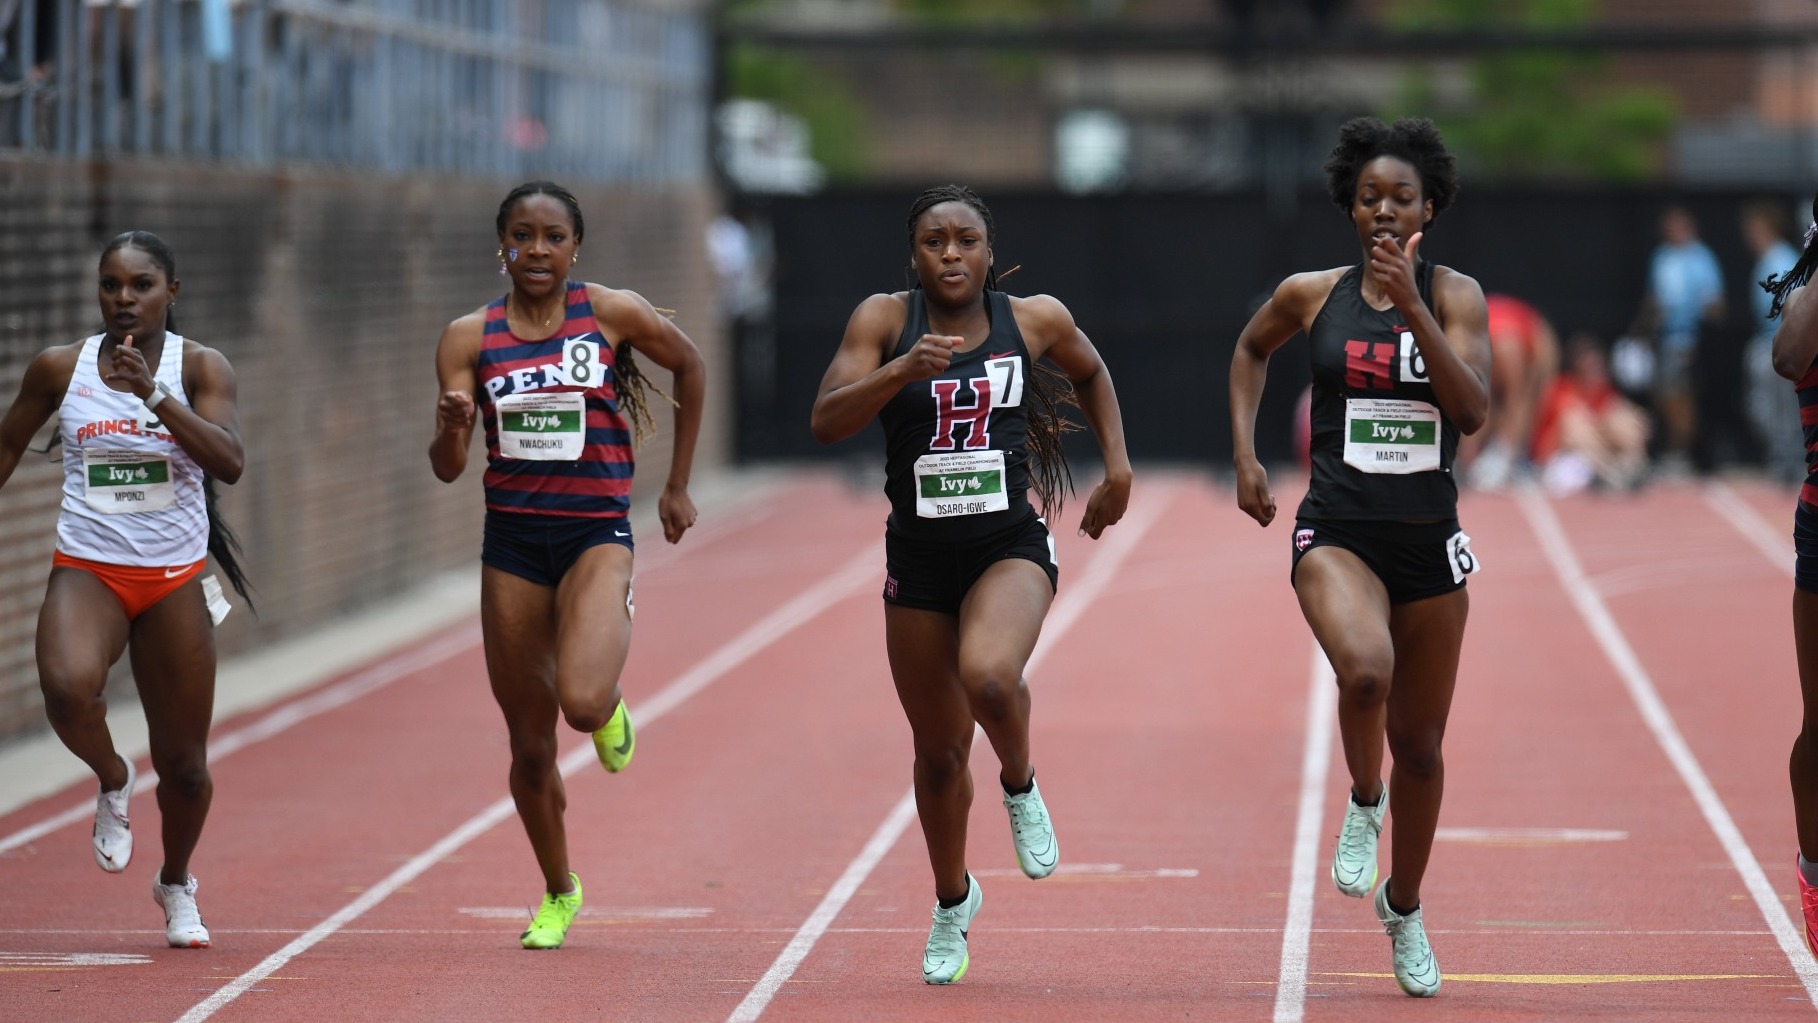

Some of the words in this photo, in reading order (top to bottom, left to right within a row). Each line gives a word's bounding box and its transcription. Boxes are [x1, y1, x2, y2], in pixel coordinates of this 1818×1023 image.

[571, 343, 591, 383] 8
[1344, 339, 1396, 390] H
[994, 360, 1015, 405] 7
[522, 412, 547, 431] Ivy
[930, 376, 993, 451] H
[77, 419, 181, 446] PRINCE
[1371, 422, 1400, 442] Ivy
[519, 438, 563, 449] NWACHUKU
[1375, 450, 1409, 463] MARTIN
[108, 466, 135, 483] Ivy
[940, 476, 967, 494] Ivy
[114, 490, 145, 502] MPONZI
[936, 501, 988, 515] OSARO-IGWE
[1454, 535, 1474, 575] 6
